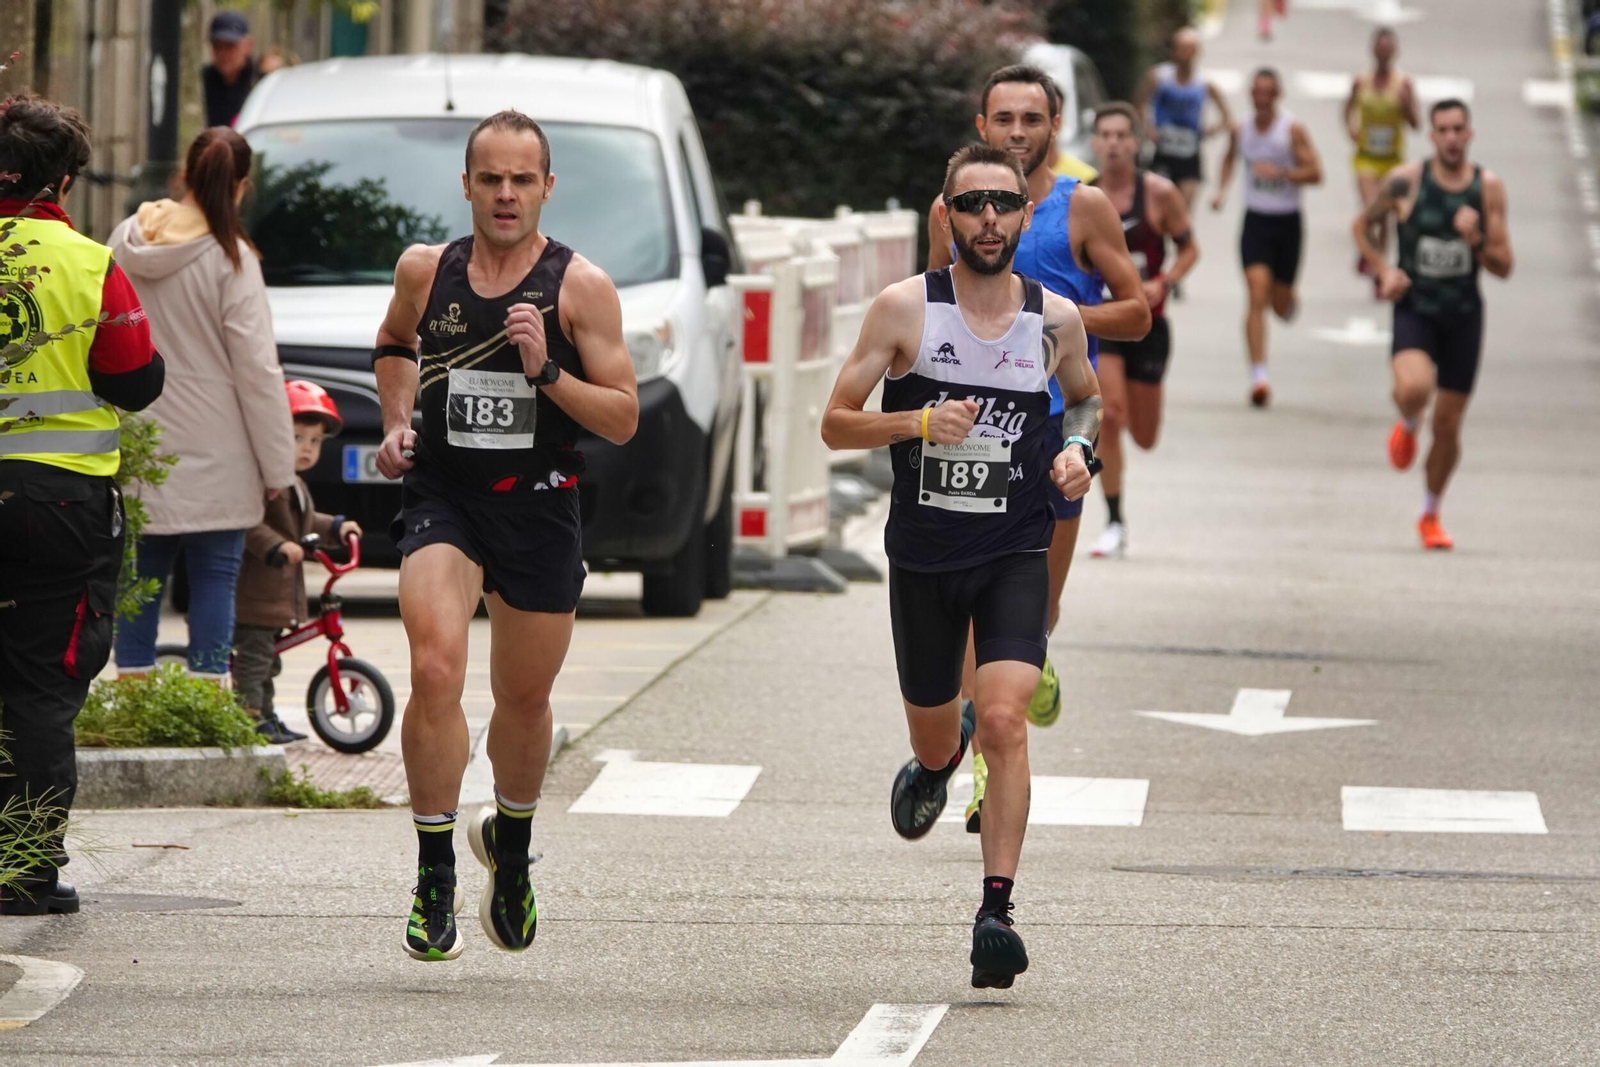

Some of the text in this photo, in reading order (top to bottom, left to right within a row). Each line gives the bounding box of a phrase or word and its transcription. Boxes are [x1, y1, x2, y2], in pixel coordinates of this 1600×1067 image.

[429, 320, 438, 331] El
[438, 321, 467, 335] Trigal
[469, 377, 479, 386] EU
[464, 396, 514, 427] 183
[939, 461, 990, 490] 189
